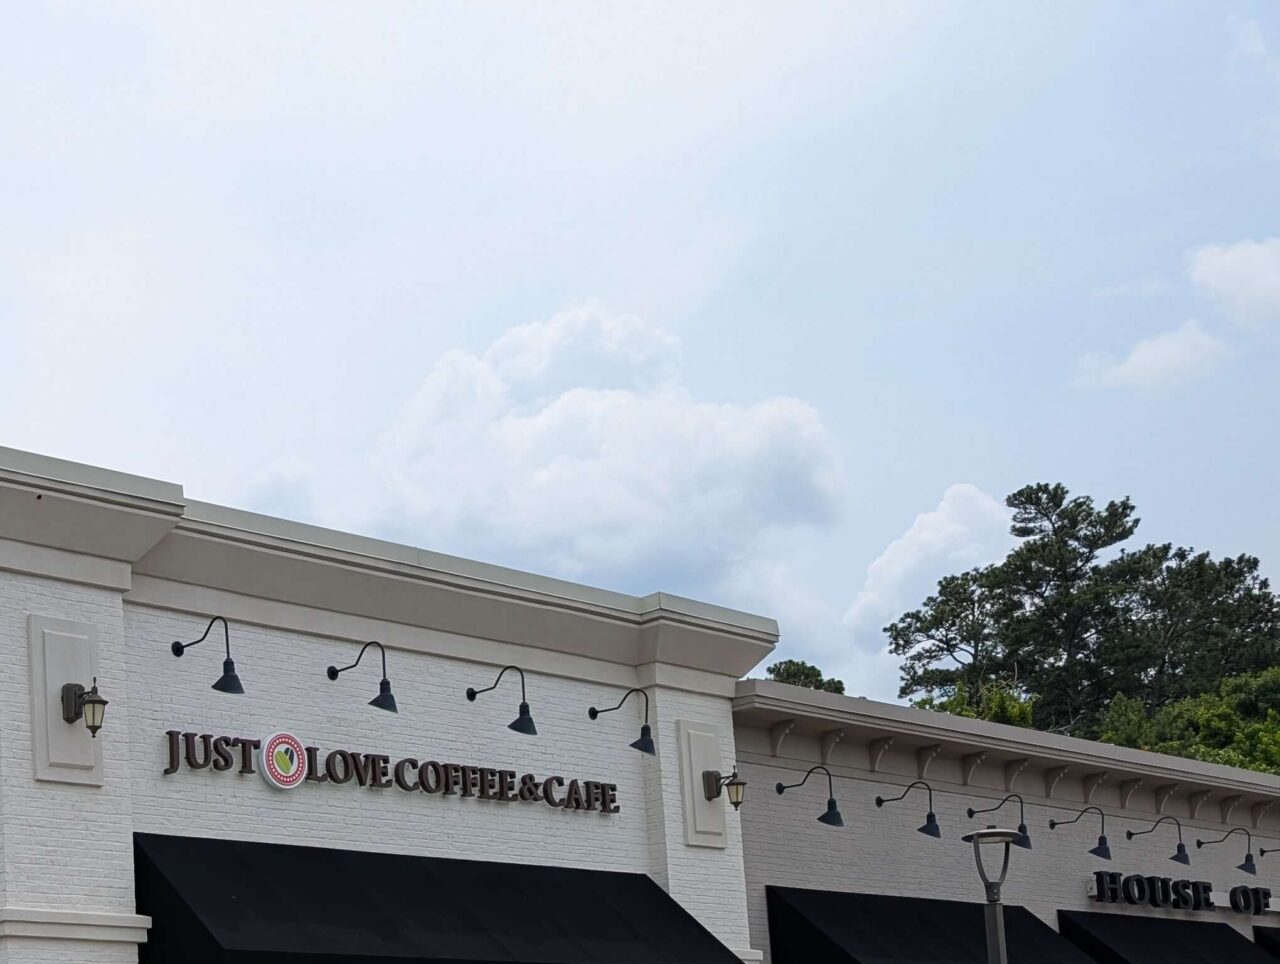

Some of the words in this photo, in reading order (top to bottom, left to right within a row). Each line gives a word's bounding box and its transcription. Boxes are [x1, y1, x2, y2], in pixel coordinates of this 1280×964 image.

[163, 730, 261, 776] JUST
[304, 746, 393, 788] LOVE
[1093, 870, 1215, 911] HOUSE
[1229, 885, 1273, 915] OF
